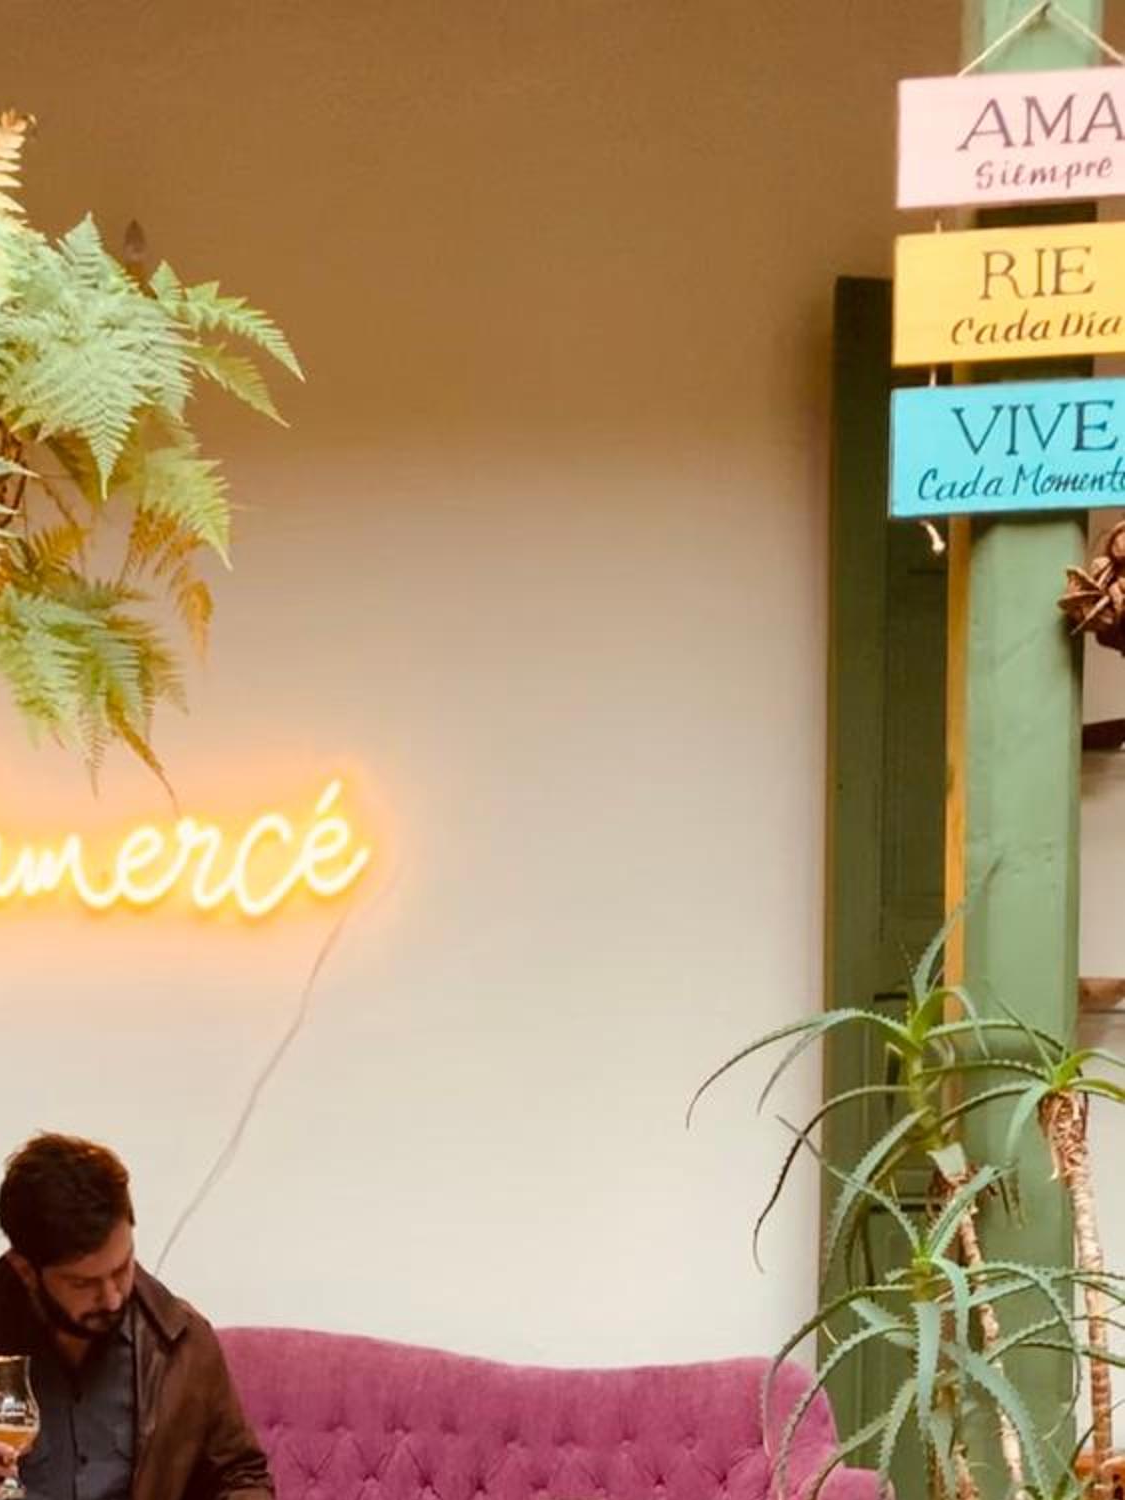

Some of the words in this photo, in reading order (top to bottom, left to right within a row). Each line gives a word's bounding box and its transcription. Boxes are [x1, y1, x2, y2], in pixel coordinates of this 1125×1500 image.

[956, 91, 1125, 151] AMA
[976, 157, 1113, 190] Siempre
[979, 246, 1097, 301] RIE
[950, 309, 1051, 346] Cada
[951, 399, 1119, 456] VIVE
[918, 464, 1004, 501] Cada
